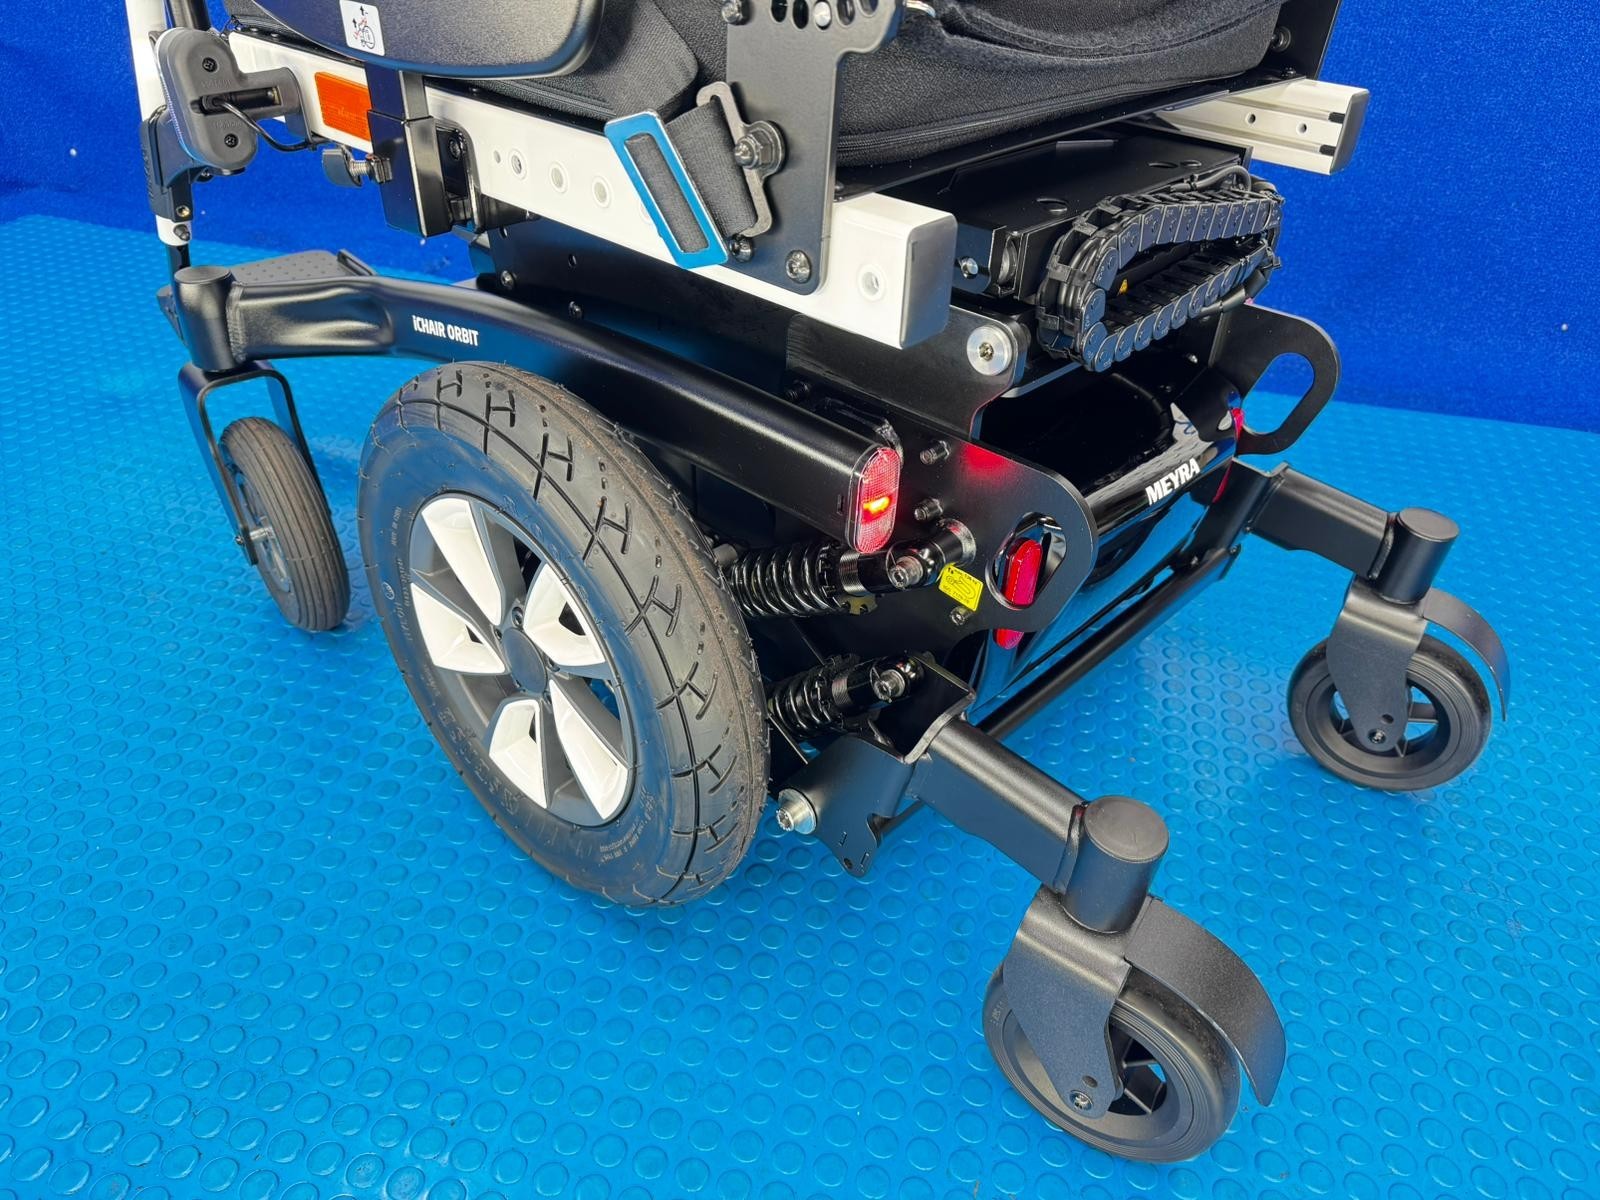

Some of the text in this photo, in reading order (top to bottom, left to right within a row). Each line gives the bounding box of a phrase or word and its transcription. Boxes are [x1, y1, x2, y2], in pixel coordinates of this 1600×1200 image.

[412, 314, 479, 346] iCHAIR ORBIT
[1145, 457, 1201, 506] MEYRA
